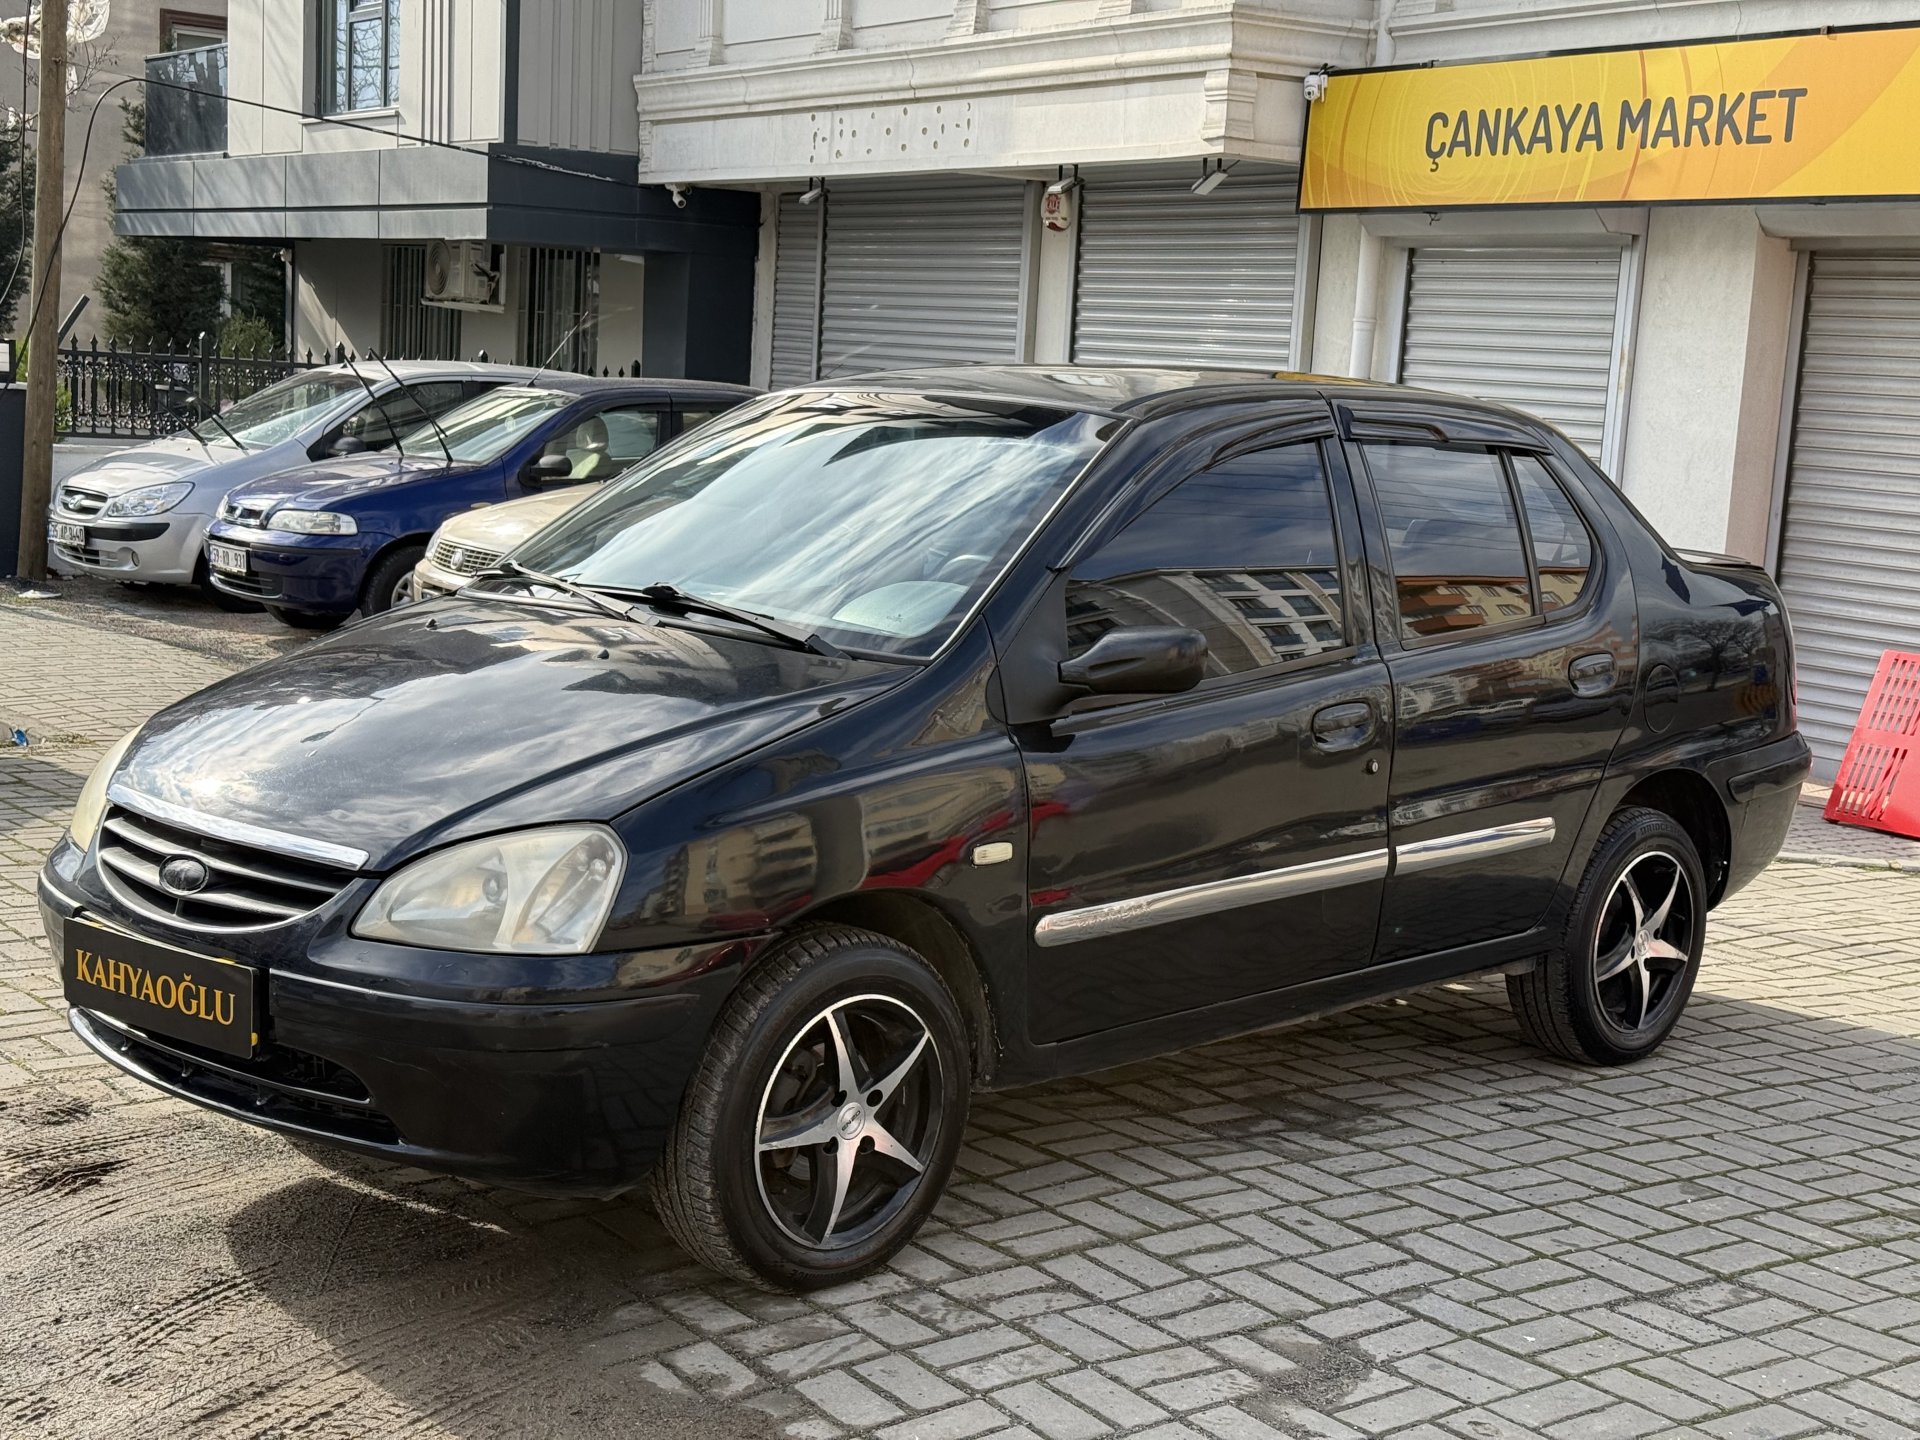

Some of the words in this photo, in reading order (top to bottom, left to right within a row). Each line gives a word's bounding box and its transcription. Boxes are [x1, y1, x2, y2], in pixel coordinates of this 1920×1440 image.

[1425, 101, 1602, 172] ÇANKAYA
[1617, 88, 1808, 151] MARKET
[234, 552, 246, 569] 931
[75, 949, 236, 1026] KAHYAOĞLU
